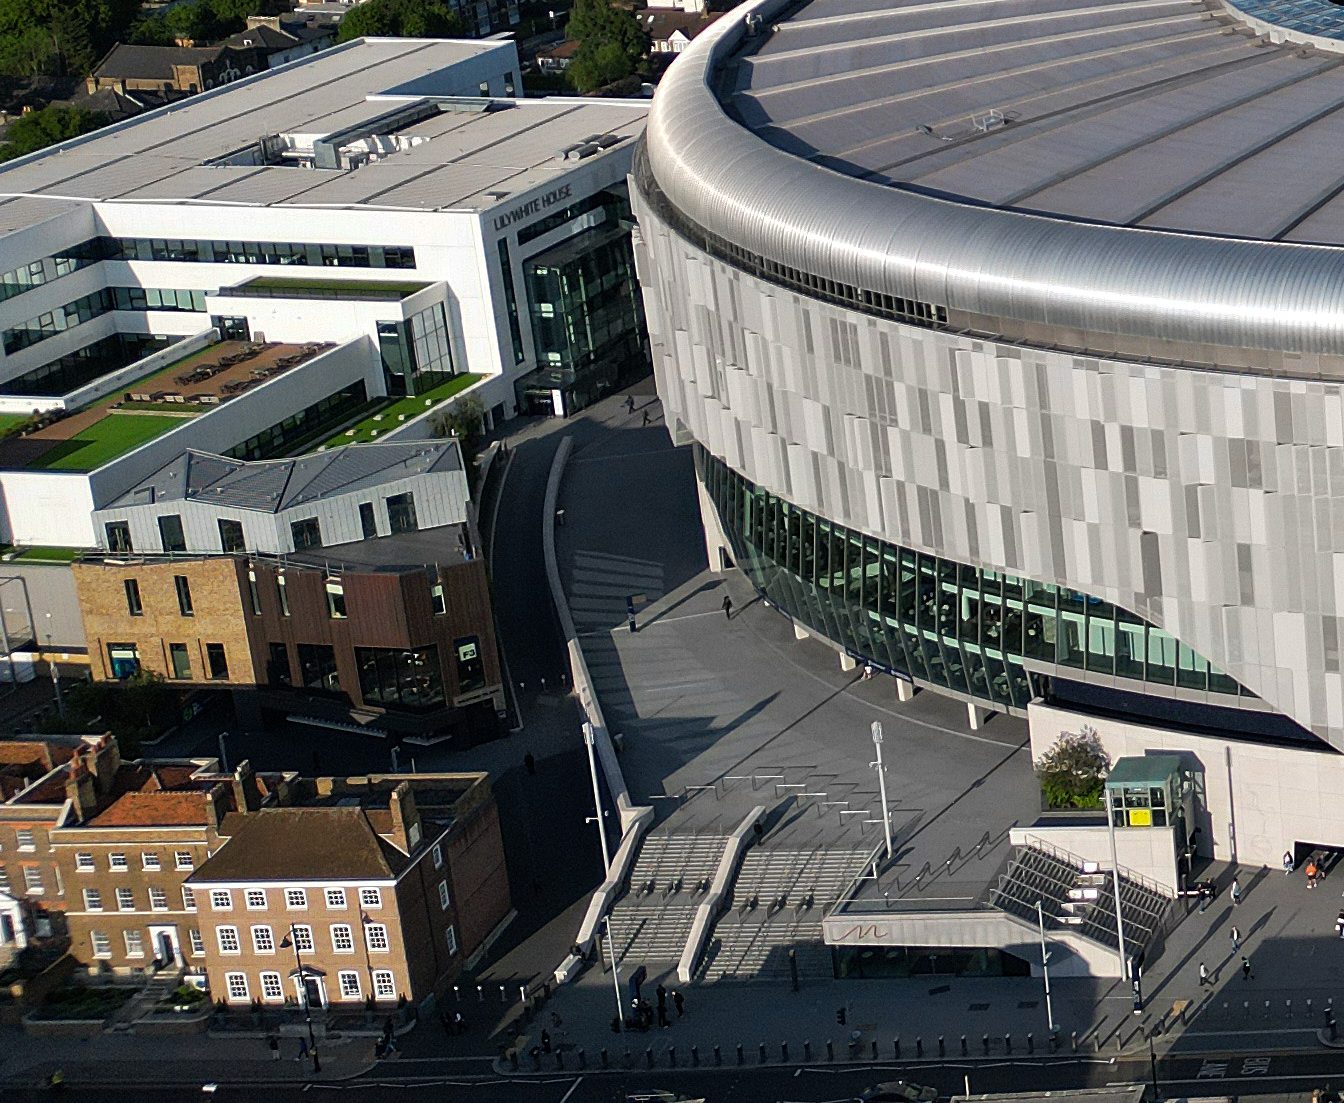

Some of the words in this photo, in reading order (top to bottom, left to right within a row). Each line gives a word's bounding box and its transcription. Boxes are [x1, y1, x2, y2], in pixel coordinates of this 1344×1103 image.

[494, 198, 541, 231] LILYWHITE
[542, 183, 573, 208] HOUSE
[1241, 1057, 1271, 1074] BUS
